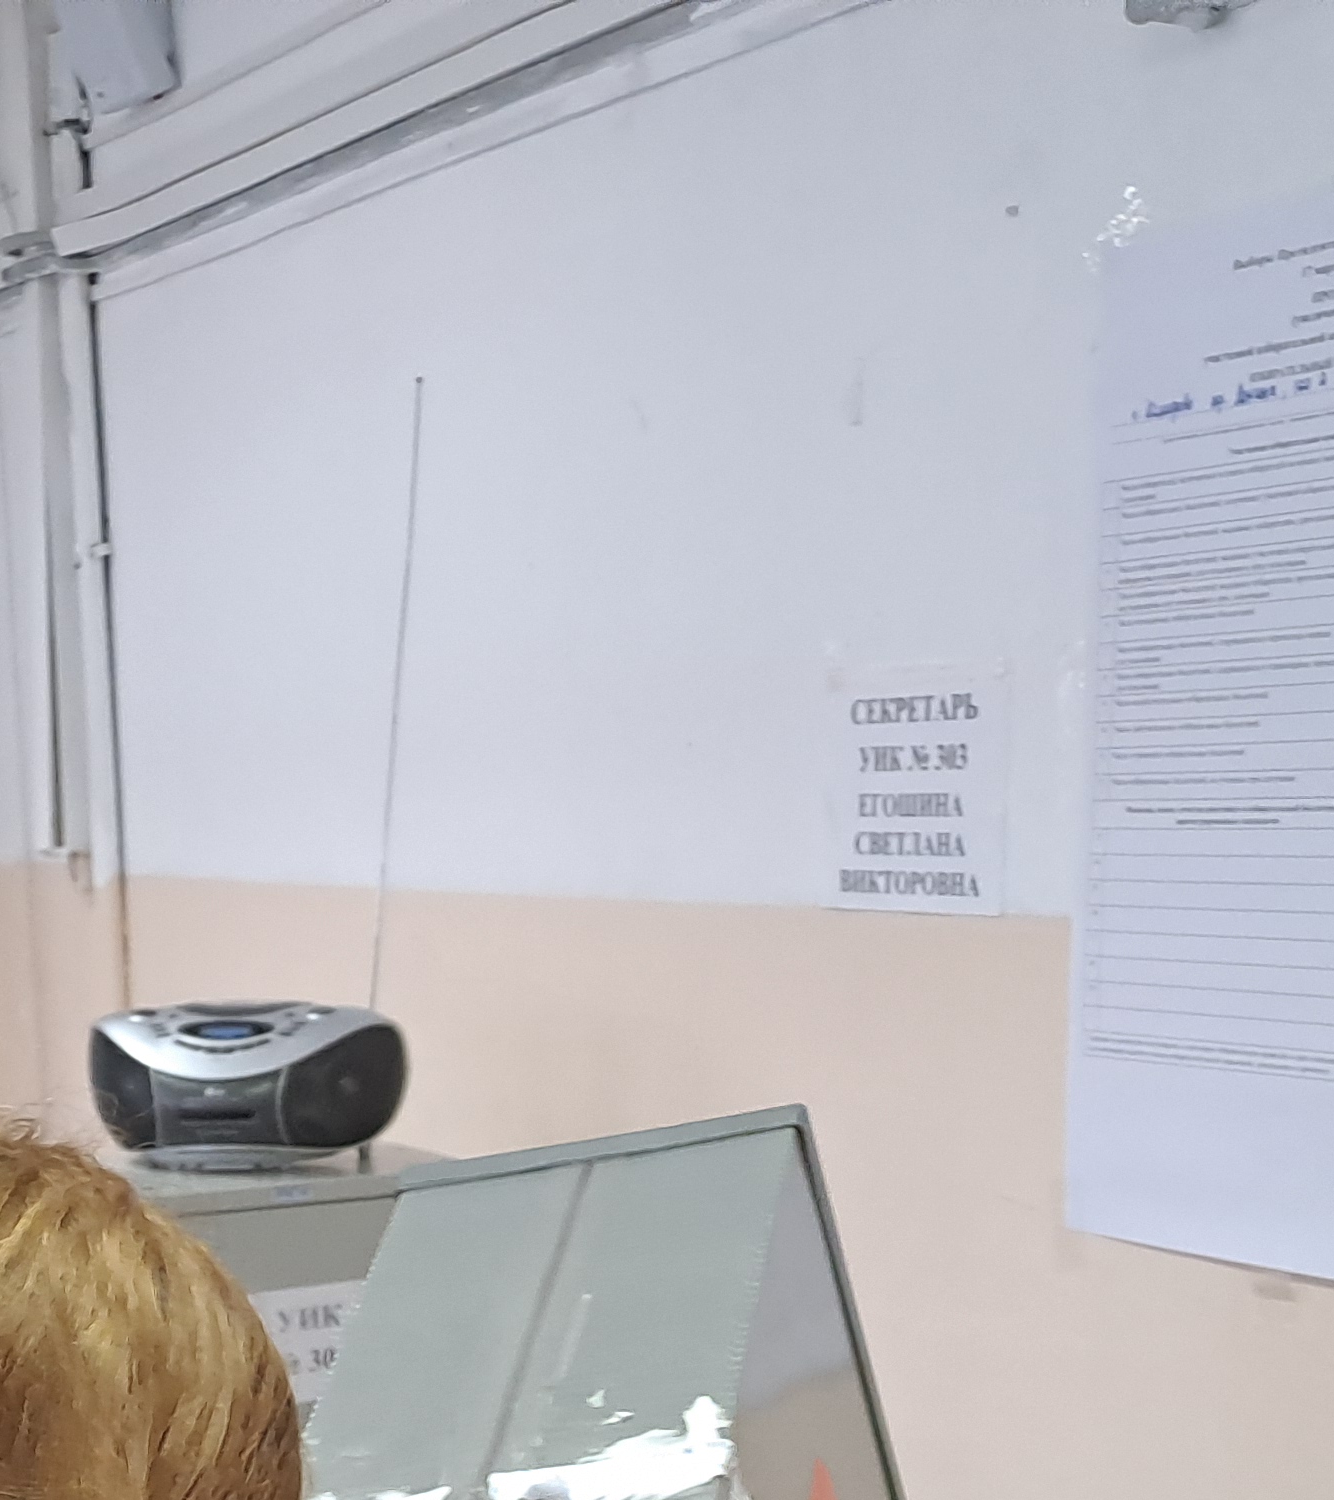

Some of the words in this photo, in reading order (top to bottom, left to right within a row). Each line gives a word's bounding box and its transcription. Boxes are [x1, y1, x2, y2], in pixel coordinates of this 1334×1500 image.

[850, 692, 979, 725] СЕКРЕТАРЬ
[859, 746, 905, 772] УИК
[858, 793, 964, 817] ЕГОШИНА
[853, 831, 966, 857] СВЕТЛАНА
[839, 869, 980, 898] ВИКТОРОВНА
[278, 1303, 343, 1333] УИК
[309, 1346, 337, 1373] 30
